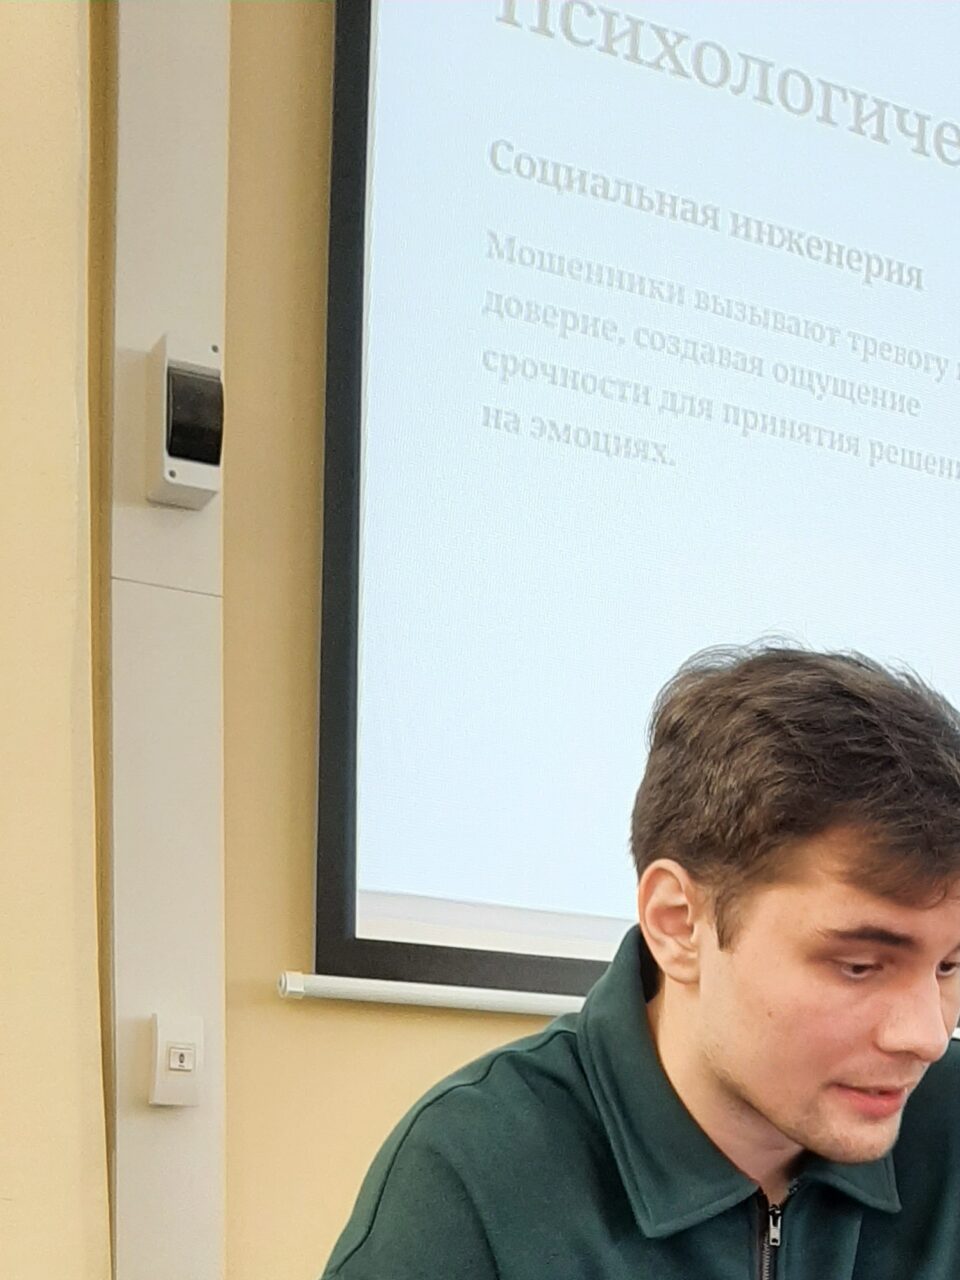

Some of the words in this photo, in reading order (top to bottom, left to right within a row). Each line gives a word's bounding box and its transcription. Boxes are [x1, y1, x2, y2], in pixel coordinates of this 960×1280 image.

[490, 140, 719, 231] Социальная
[731, 213, 923, 291] инженерия
[482, 291, 625, 345] доверие,
[634, 328, 763, 377] создавая
[773, 364, 920, 417] ощущение
[487, 230, 684, 305] Мошенники
[695, 290, 841, 346] вызывают
[848, 332, 949, 383] тревогу
[483, 350, 650, 406] срочности
[658, 390, 713, 420] для
[724, 404, 859, 456] принятия
[483, 406, 520, 434] на
[530, 417, 675, 466] эмоциях.
